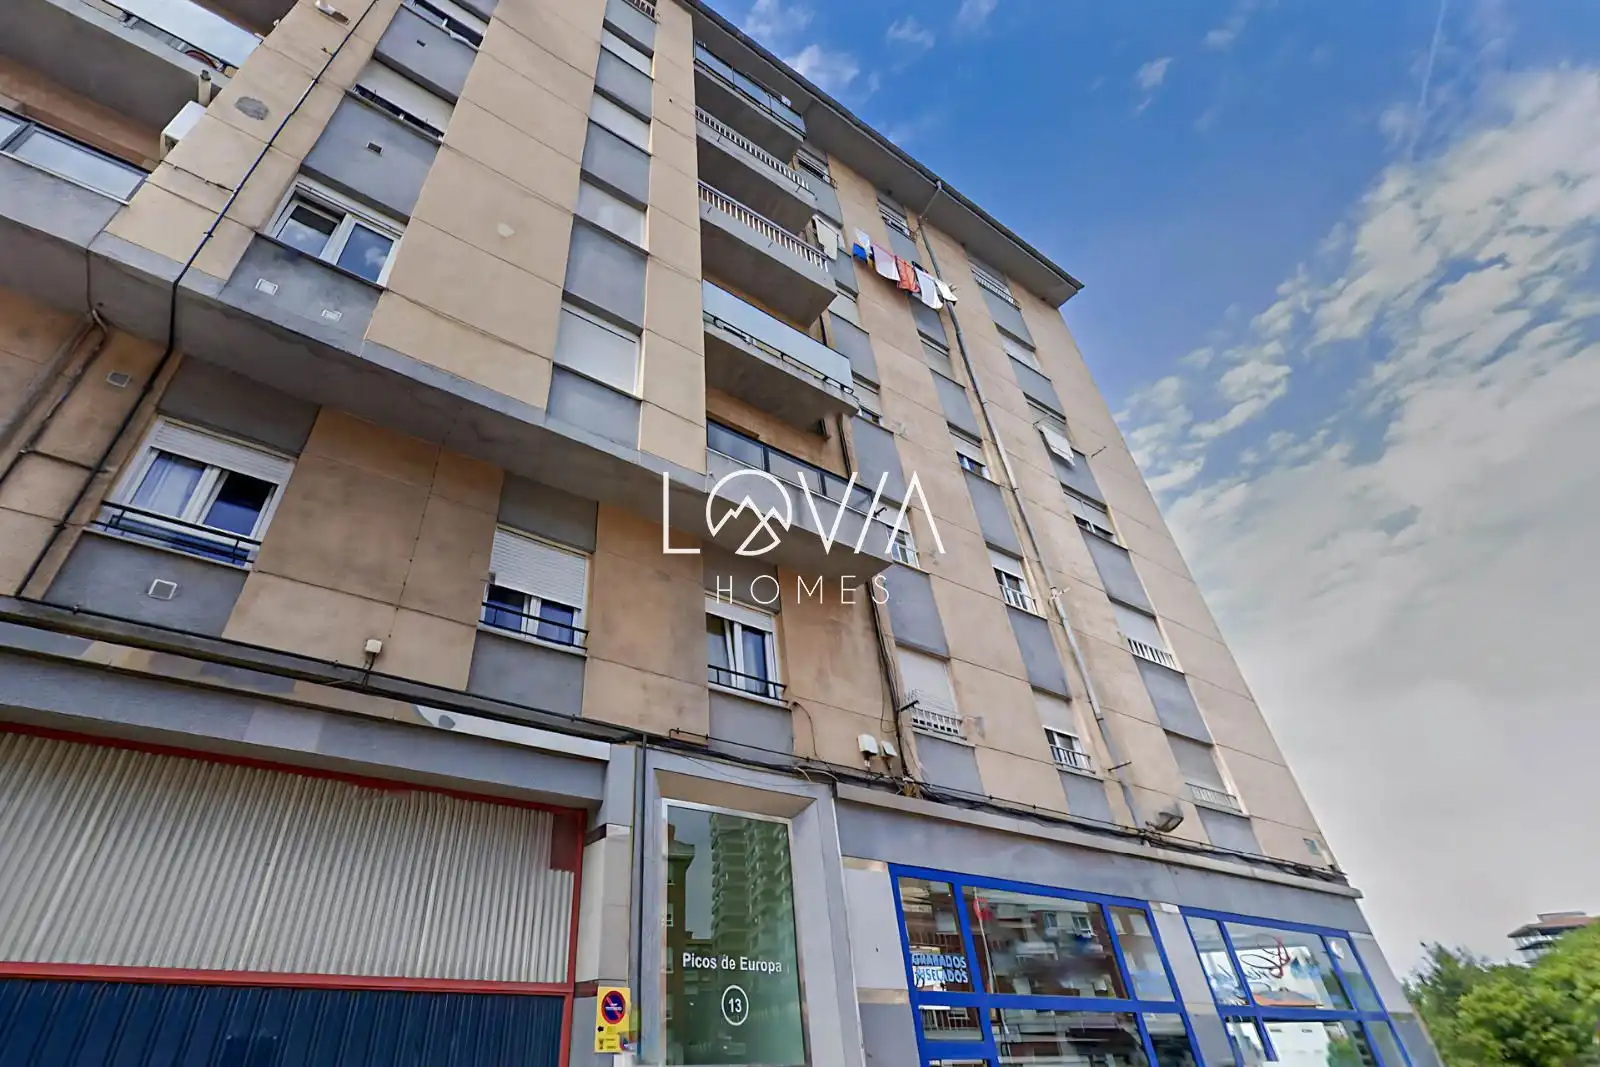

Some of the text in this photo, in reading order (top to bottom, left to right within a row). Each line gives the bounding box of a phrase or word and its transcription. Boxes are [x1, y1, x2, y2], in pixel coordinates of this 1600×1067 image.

[682, 952, 782, 974] Picos de Europa
[915, 968, 968, 983] SELADOS
[728, 998, 742, 1013] 13
